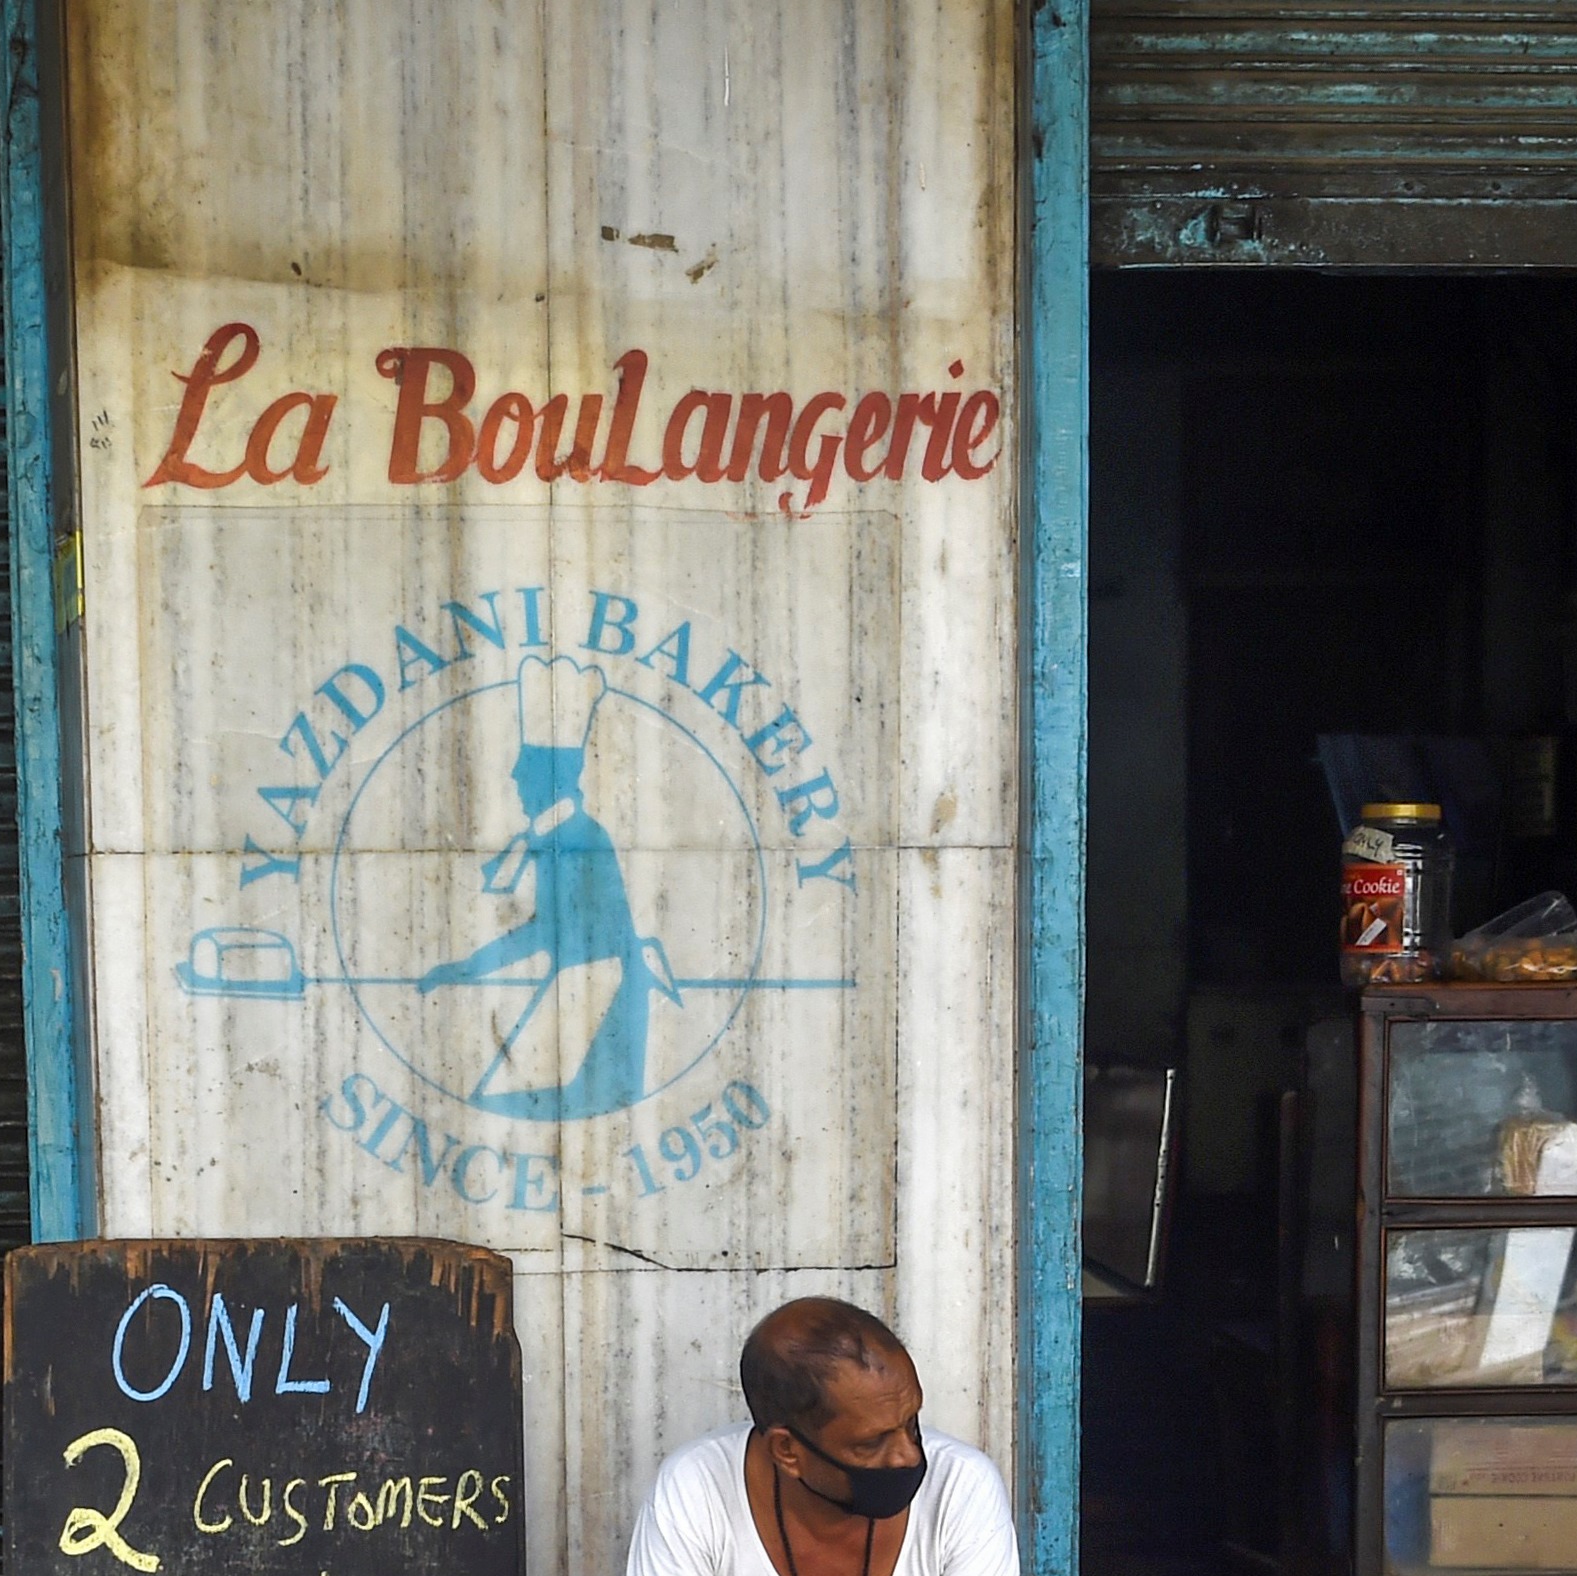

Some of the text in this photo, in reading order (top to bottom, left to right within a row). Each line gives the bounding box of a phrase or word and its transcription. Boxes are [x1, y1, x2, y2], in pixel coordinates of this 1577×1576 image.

[143, 322, 339, 491] La
[239, 586, 858, 894] YAZDANI BAKERY
[1353, 876, 1401, 896] Cookie
[319, 1070, 560, 1213] SINCE
[620, 1078, 774, 1200] 1950
[111, 1283, 392, 1413] ONLY
[58, 1426, 162, 1574] 2
